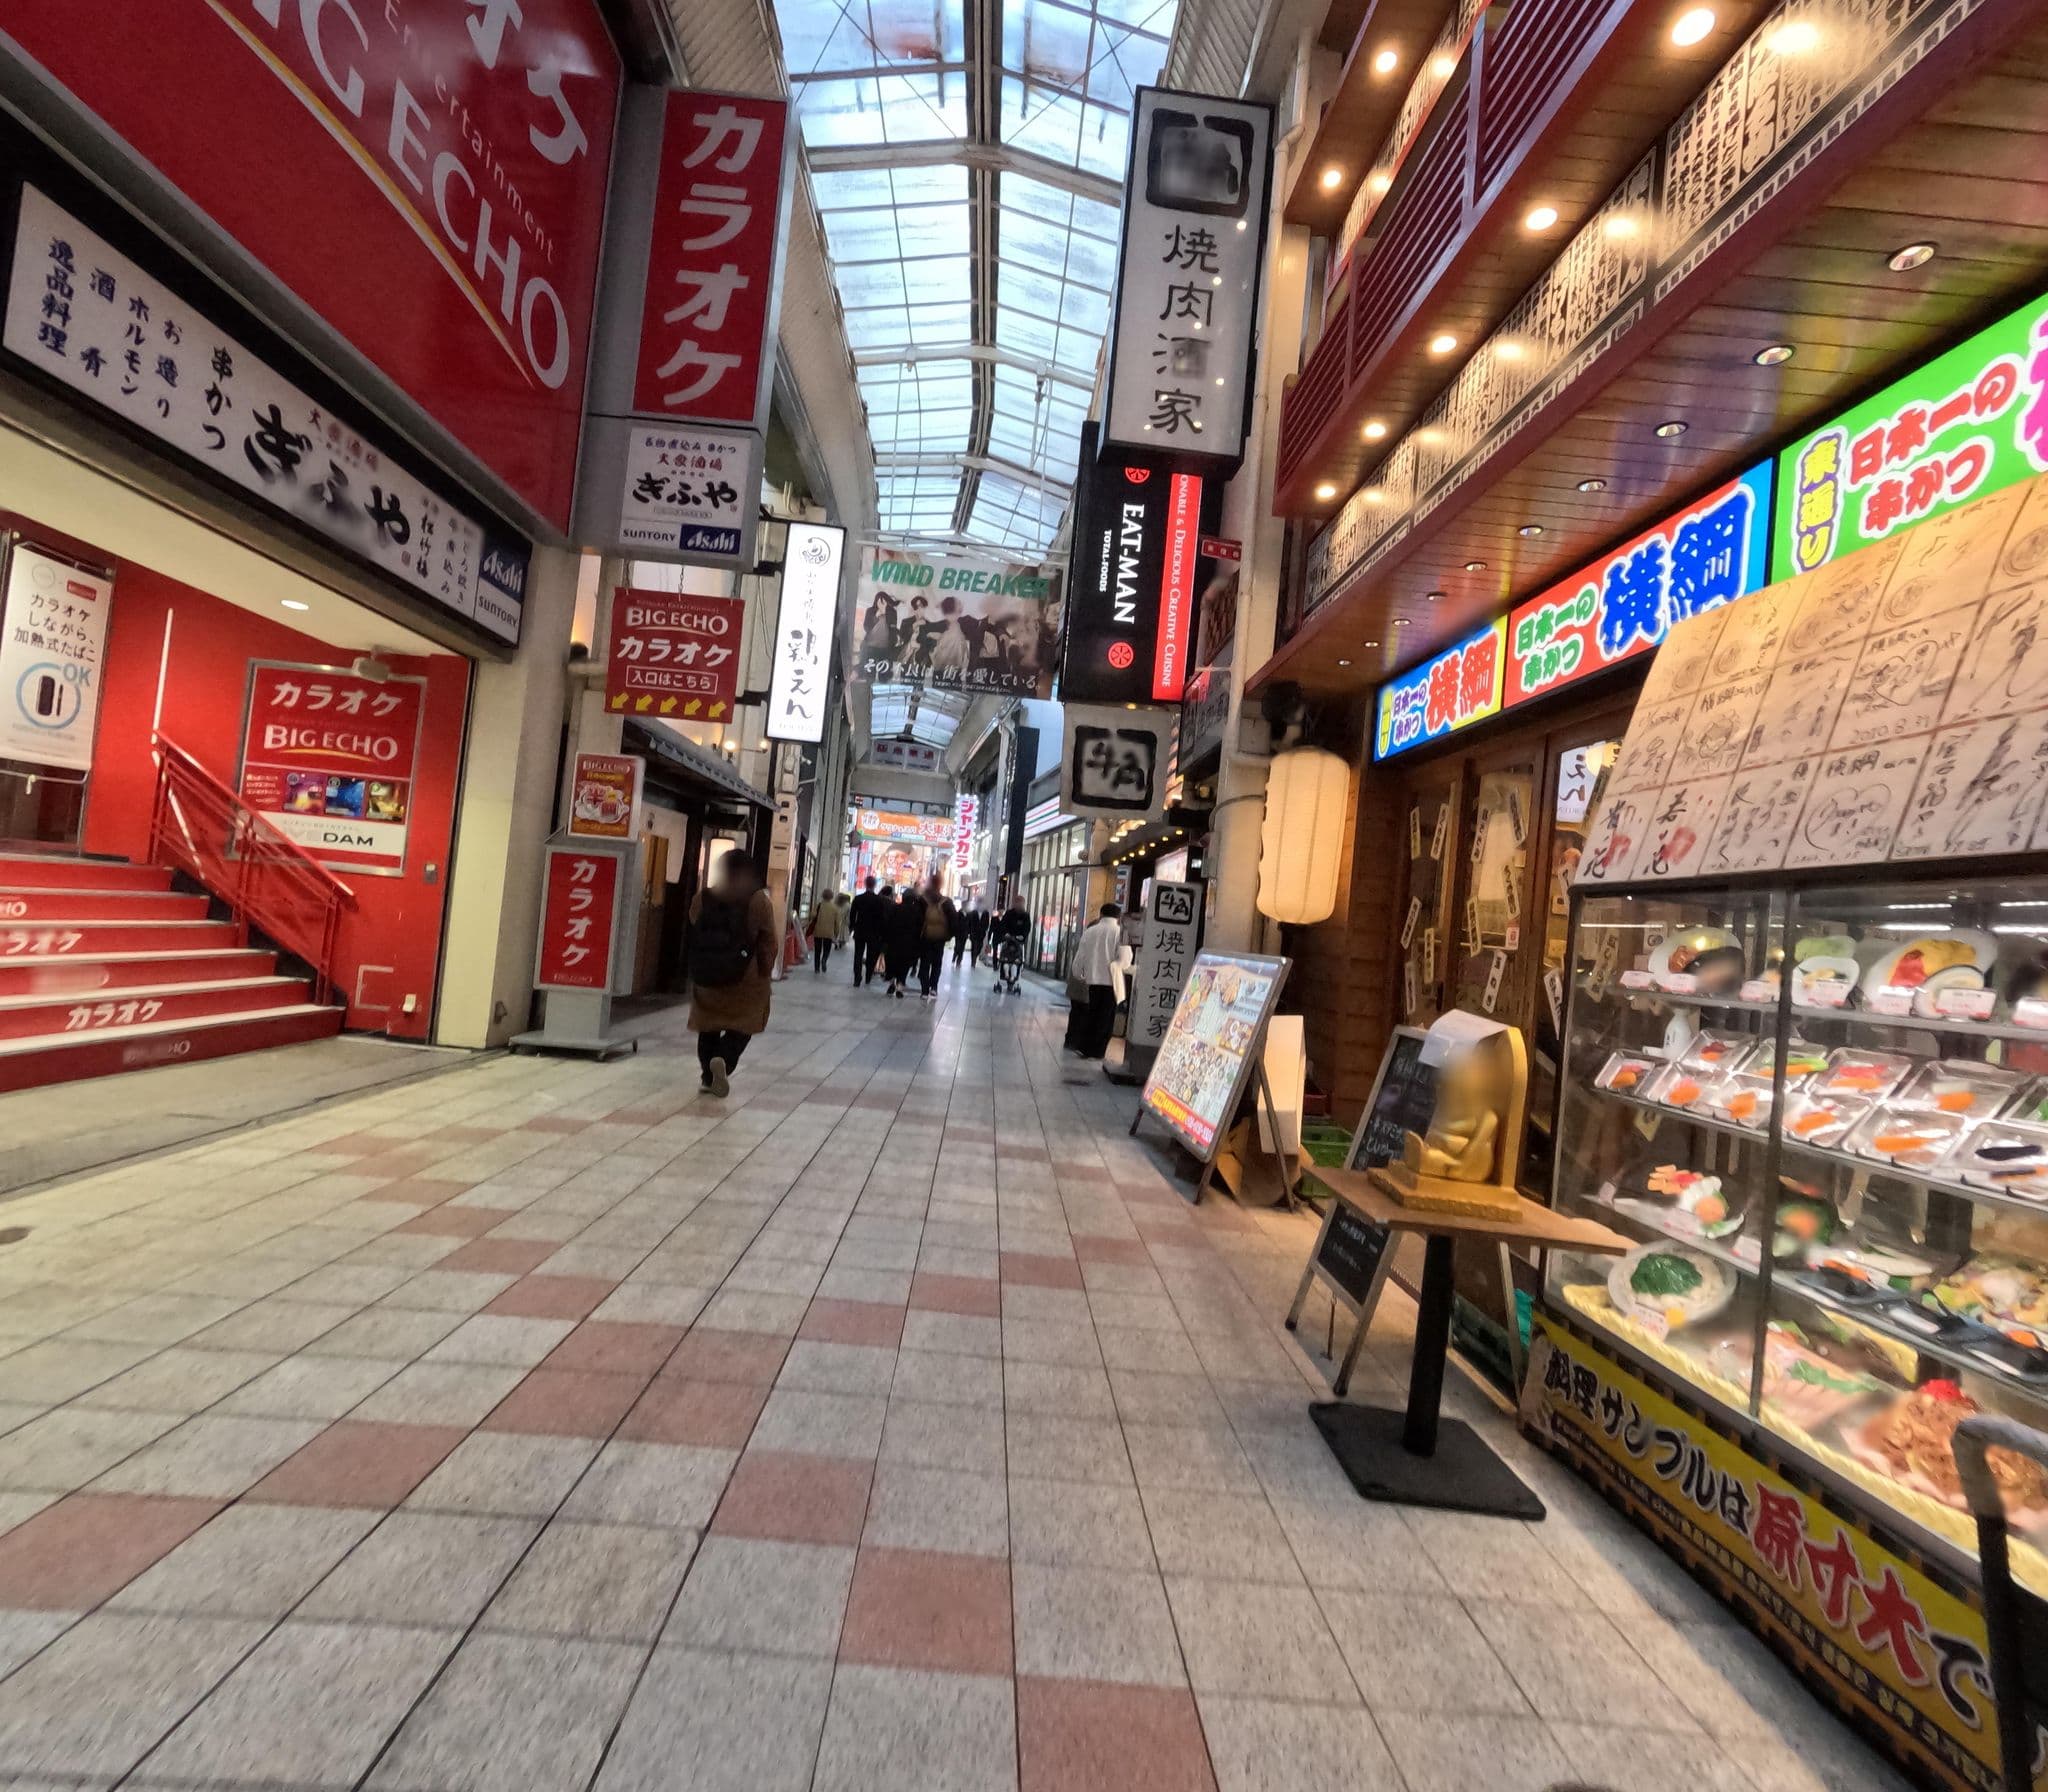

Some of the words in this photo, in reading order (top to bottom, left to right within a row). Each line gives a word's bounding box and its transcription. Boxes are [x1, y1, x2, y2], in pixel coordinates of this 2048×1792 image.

[387, 78, 571, 390] ECHO
[655, 106, 764, 406] カラオケ
[37, 236, 76, 358] 逸品料理
[121, 296, 150, 395] ホルモン
[155, 319, 183, 418] お造り
[202, 346, 234, 450] 串かつ
[1851, 362, 2017, 485] 日本一の
[633, 472, 737, 508] ぎふや
[1866, 445, 1986, 531] 串かつ
[623, 529, 676, 542] SUNTORY
[687, 530, 735, 551] Asahi
[483, 550, 523, 594] Asahi
[871, 559, 934, 588] WIND
[938, 567, 1049, 599] BREAKER
[1113, 503, 1154, 625] EAT-MAN
[28, 610, 95, 645] しながら、
[30, 592, 91, 622] カラオケ
[478, 595, 517, 628] SUNTORY
[625, 605, 667, 627] BIG
[671, 611, 729, 635] ECHO
[1167, 588, 1181, 641] CREATIVE
[1518, 589, 1596, 656] 日本一の
[14, 626, 96, 663] 加熱式たばこ
[617, 636, 732, 667] カラオケ
[1162, 643, 1177, 688] CUISINE
[1524, 640, 1582, 688] 串かつ
[62, 662, 92, 687] OK
[632, 671, 711, 689] 入口はこちら
[270, 681, 403, 717] カラオケ
[264, 724, 316, 750] BIG
[322, 731, 398, 761] ECHO
[323, 832, 374, 846] DAM
[956, 800, 975, 868] ジャンカラ
[563, 859, 597, 966] カラオケ
[1147, 929, 1185, 1039] 焼肉酒家
[65, 1000, 163, 1031] カラオケ
